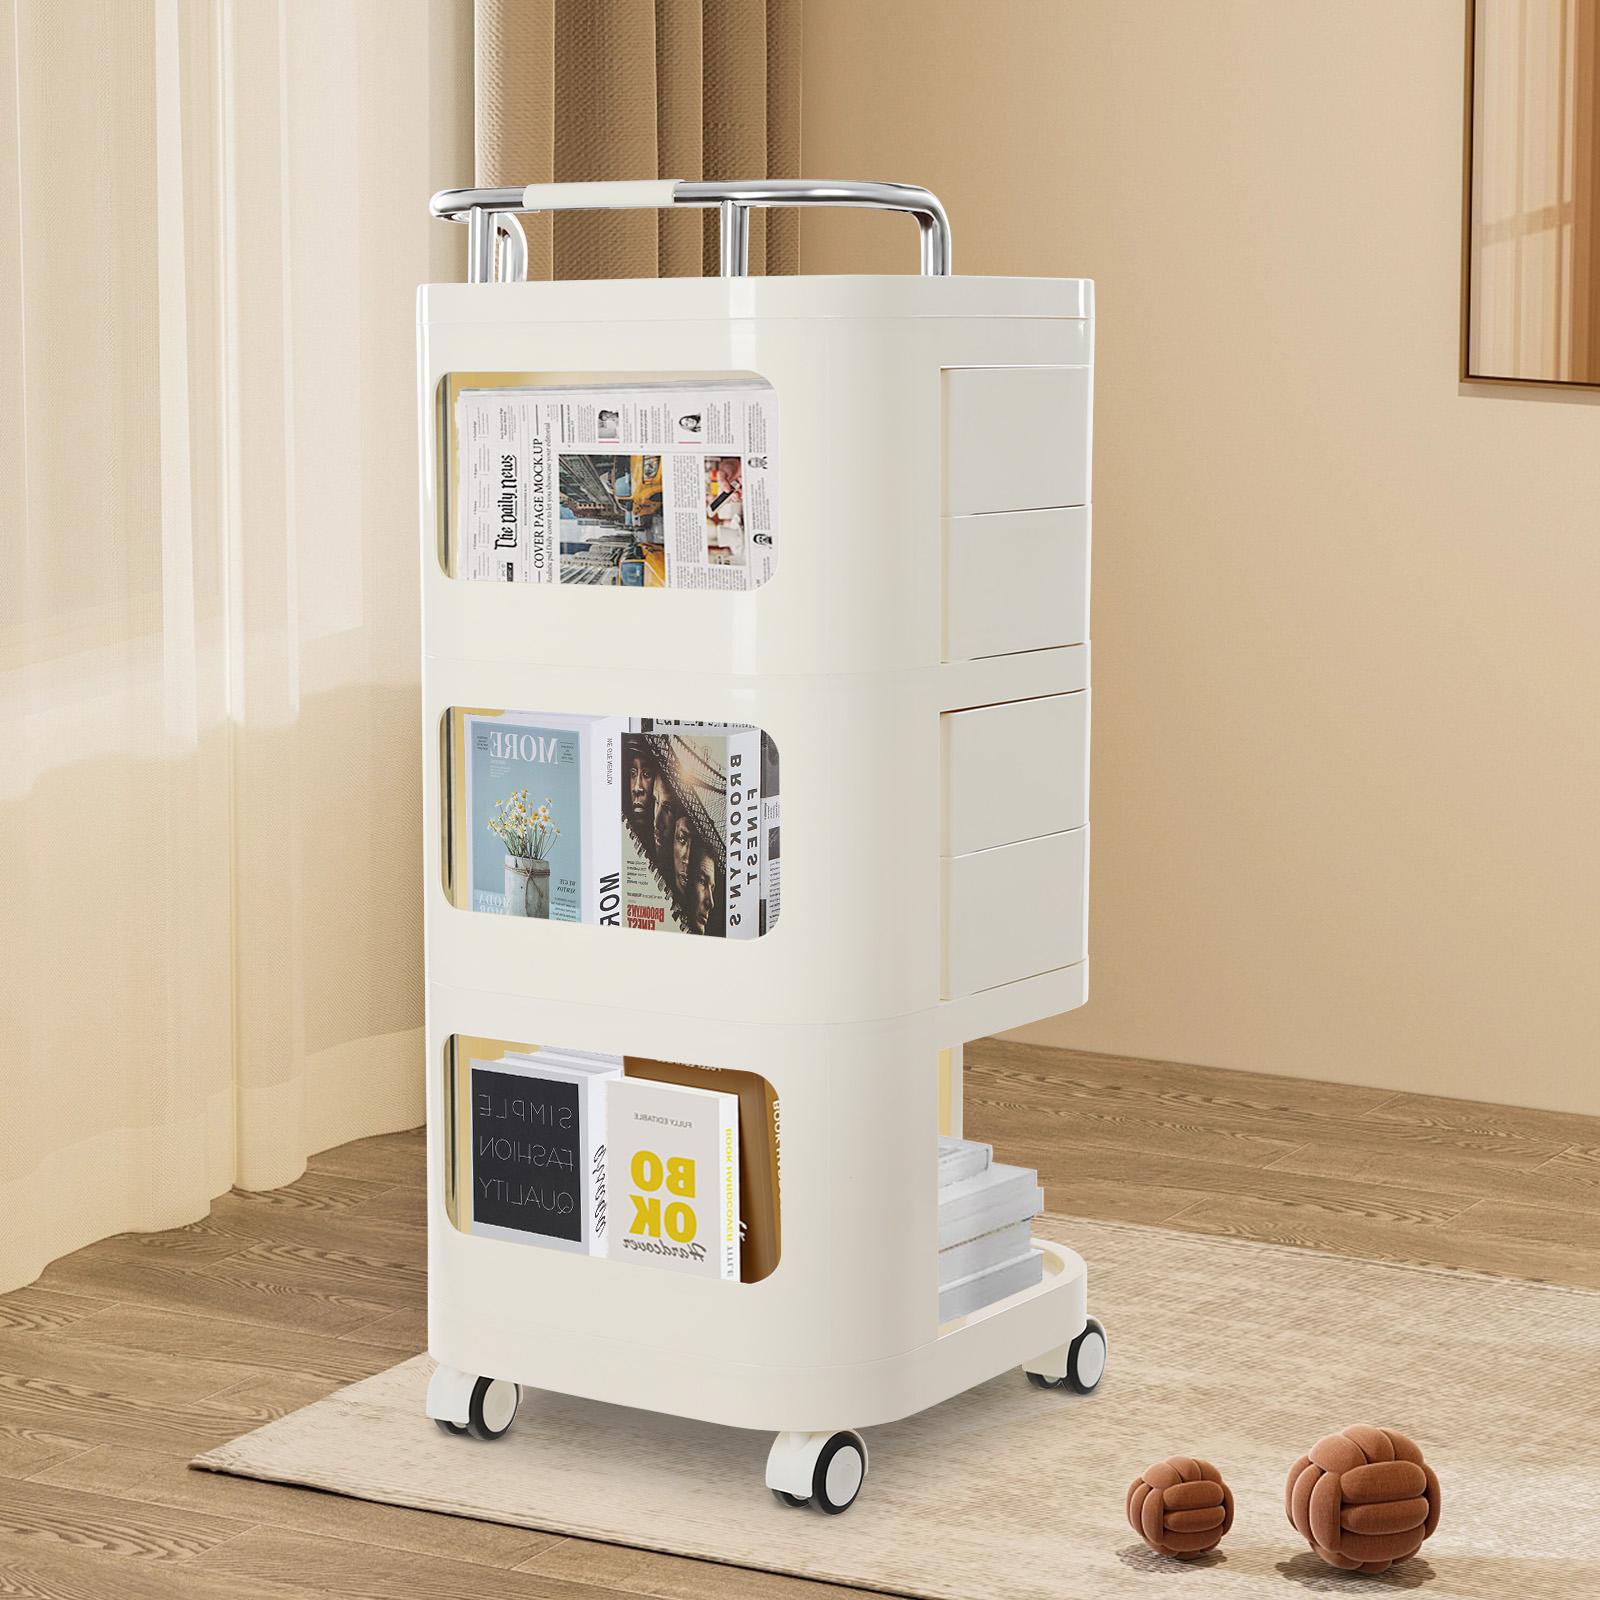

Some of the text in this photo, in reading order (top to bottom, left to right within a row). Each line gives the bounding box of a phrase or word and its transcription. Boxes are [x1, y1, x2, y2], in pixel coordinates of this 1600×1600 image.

[534, 496, 544, 528] PAGE
[494, 527, 517, 550] The
[534, 531, 544, 568] COVER
[545, 536, 553, 550] Daily
